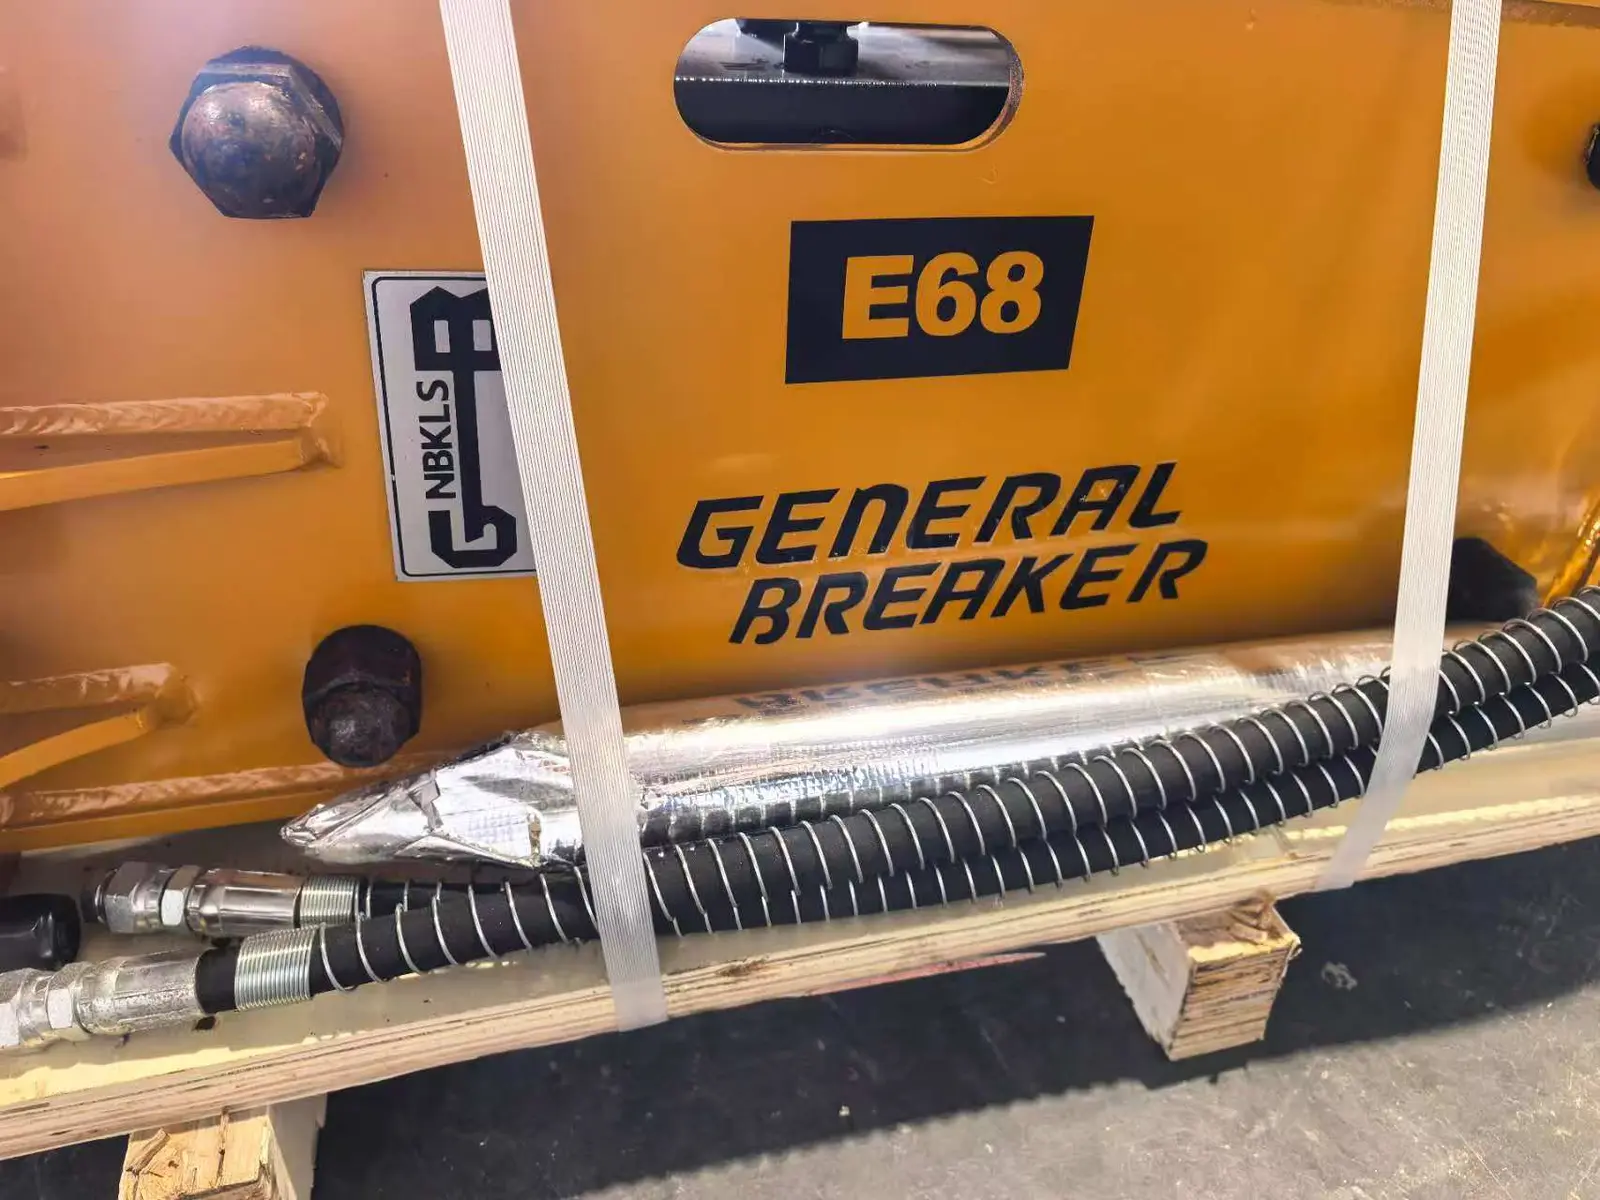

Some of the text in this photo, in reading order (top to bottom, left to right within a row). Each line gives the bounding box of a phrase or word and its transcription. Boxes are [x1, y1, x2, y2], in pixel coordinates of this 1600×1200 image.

[841, 251, 1044, 340] E68
[416, 379, 456, 500] NBKLS
[676, 462, 1178, 569] GENERAL
[728, 539, 1208, 645] BREAKER
